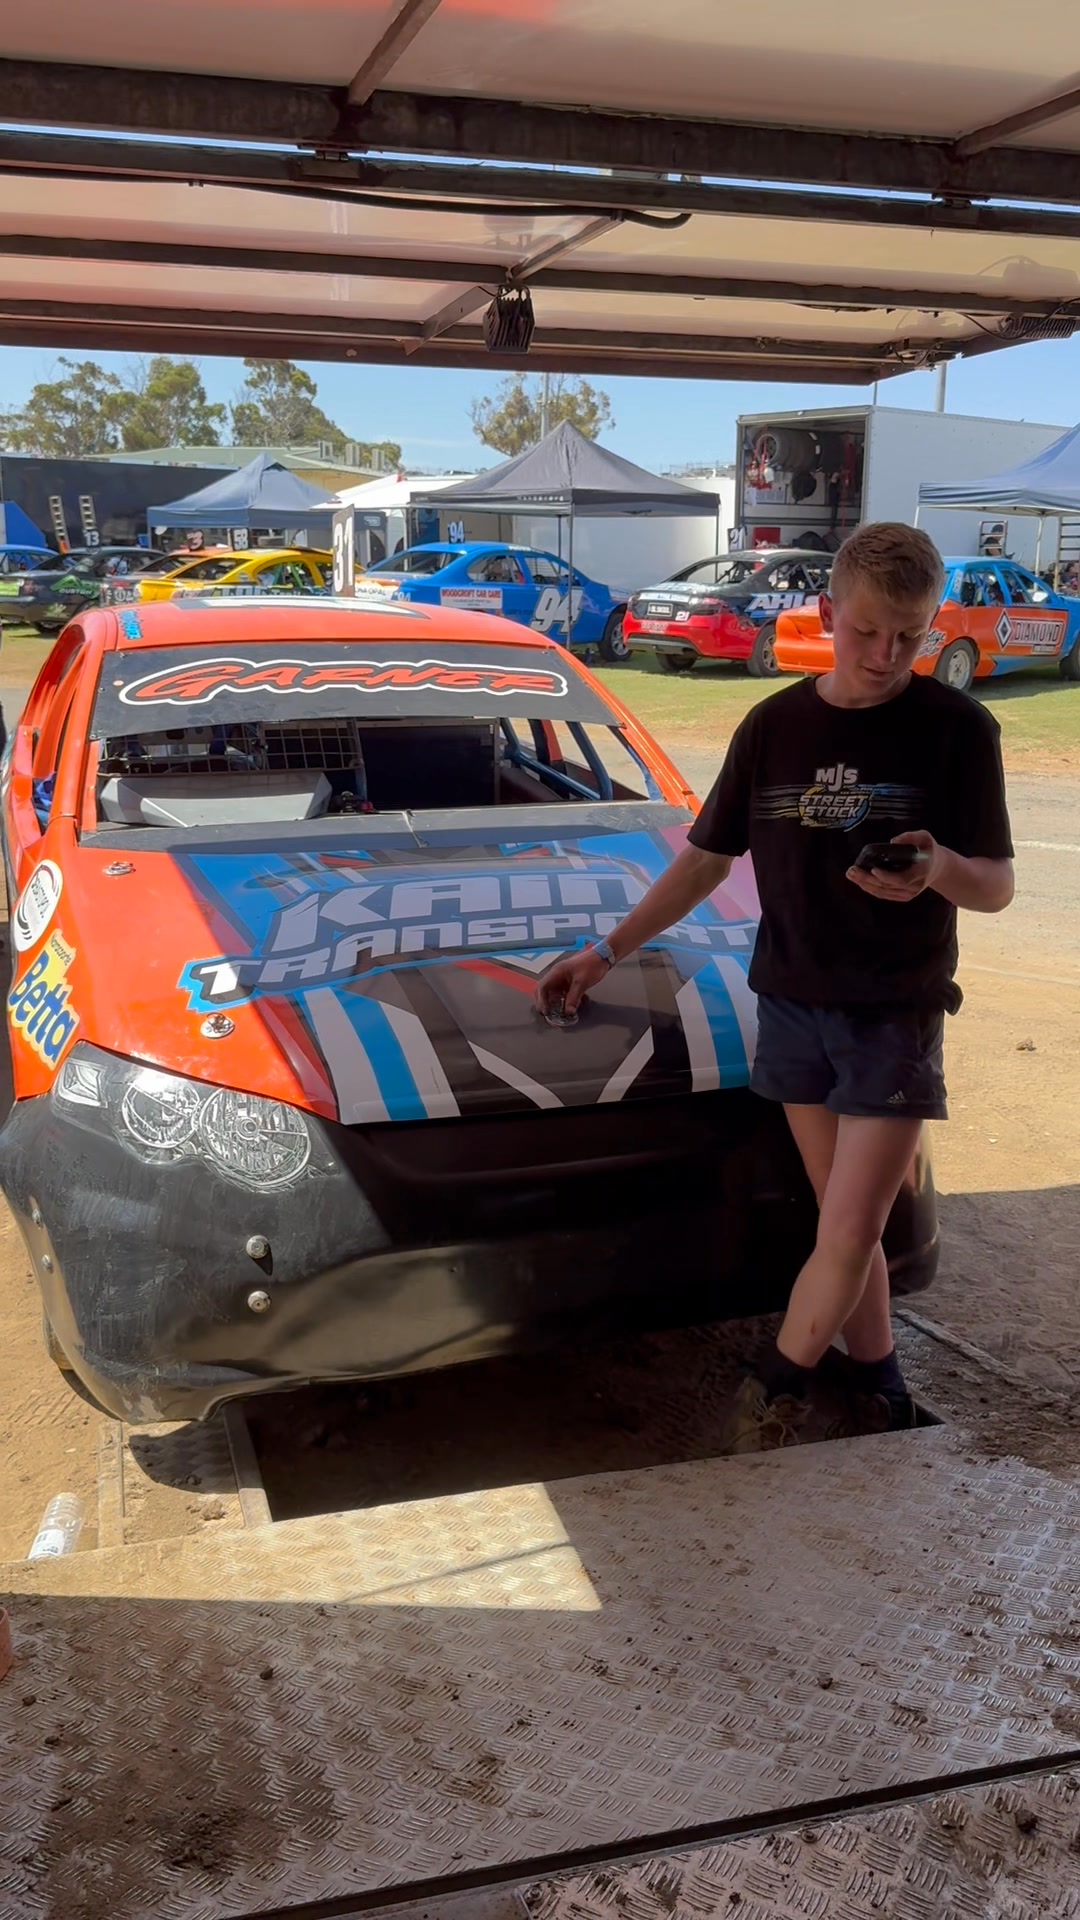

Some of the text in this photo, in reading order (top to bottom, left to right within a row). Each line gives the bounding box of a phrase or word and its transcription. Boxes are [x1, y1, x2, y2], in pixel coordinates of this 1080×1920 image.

[84, 531, 100, 546] 13
[450, 521, 465, 543] 94
[730, 527, 745, 550] 21
[531, 587, 584, 632] 94
[675, 611, 690, 621] 21
[1015, 621, 1060, 642] DIAMOND
[135, 665, 555, 697] GARNER
[815, 764, 859, 791] MJS
[799, 796, 869, 807] STREET
[805, 807, 859, 818] STOCK
[270, 873, 650, 952] KAIN
[8, 950, 76, 1063] Betta
